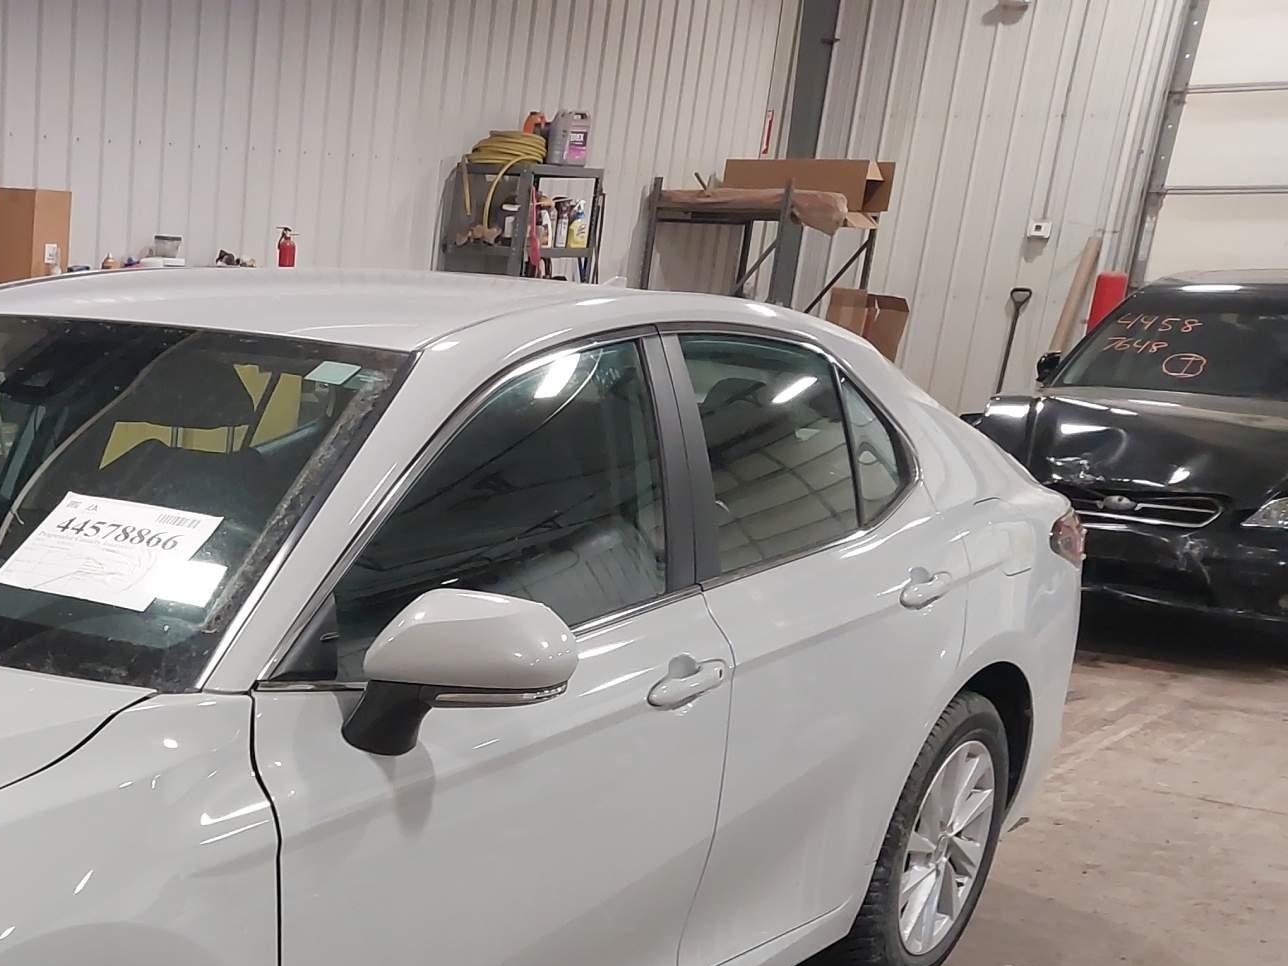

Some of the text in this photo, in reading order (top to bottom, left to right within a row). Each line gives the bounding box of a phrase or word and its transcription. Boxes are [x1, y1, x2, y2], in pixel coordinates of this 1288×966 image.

[1116, 312, 1203, 333] 4458
[1102, 335, 1169, 354] 7648
[56, 516, 185, 551] 44578866
